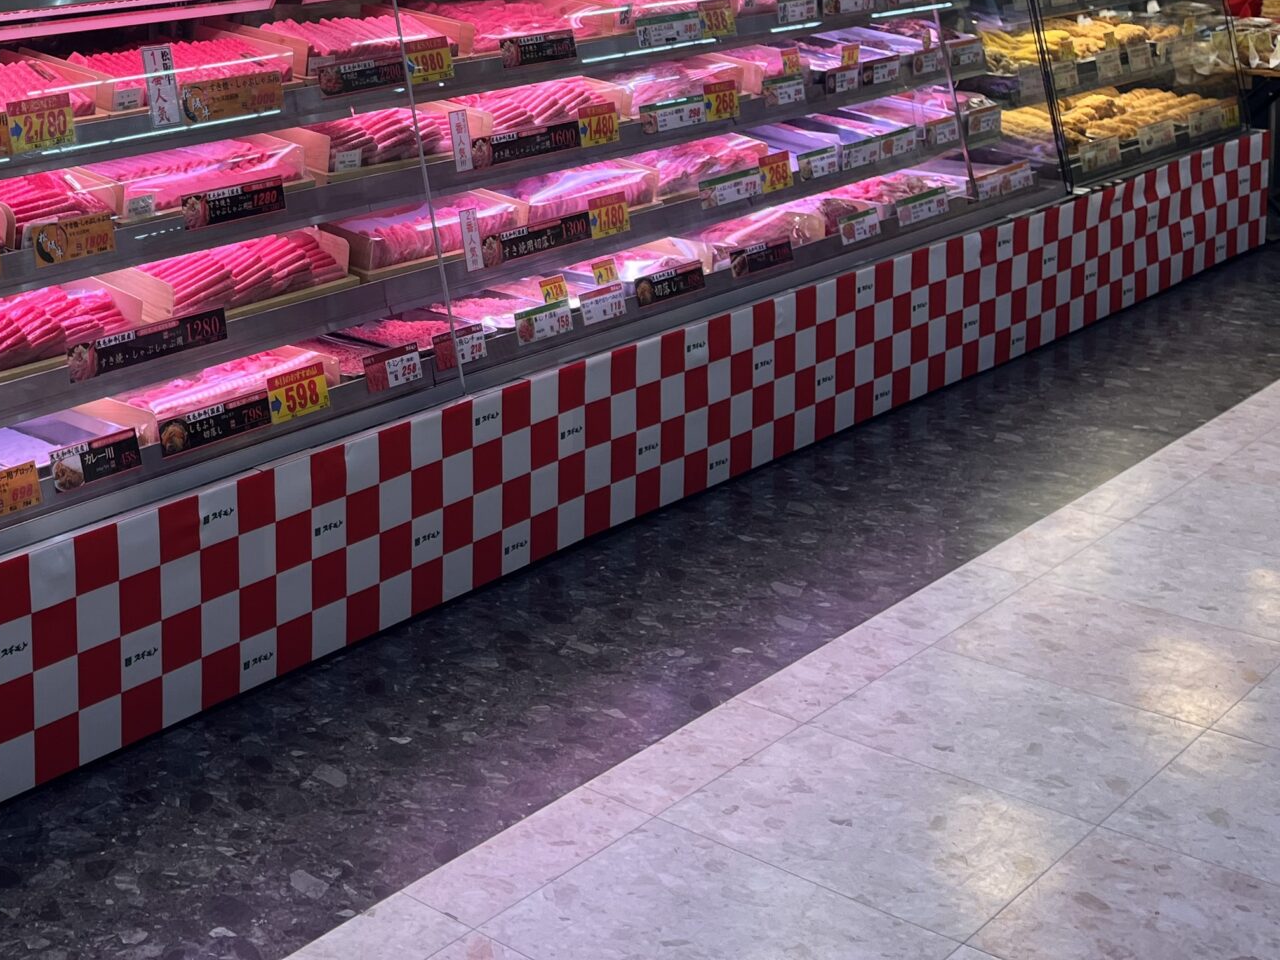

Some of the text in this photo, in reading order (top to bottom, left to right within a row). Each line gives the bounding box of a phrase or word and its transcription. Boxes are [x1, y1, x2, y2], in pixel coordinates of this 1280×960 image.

[715, 93, 734, 113] 268
[24, 112, 67, 142] 2,780
[769, 165, 789, 183] 268
[185, 315, 220, 340] 1280
[402, 363, 417, 377] 258
[285, 386, 320, 412] 598
